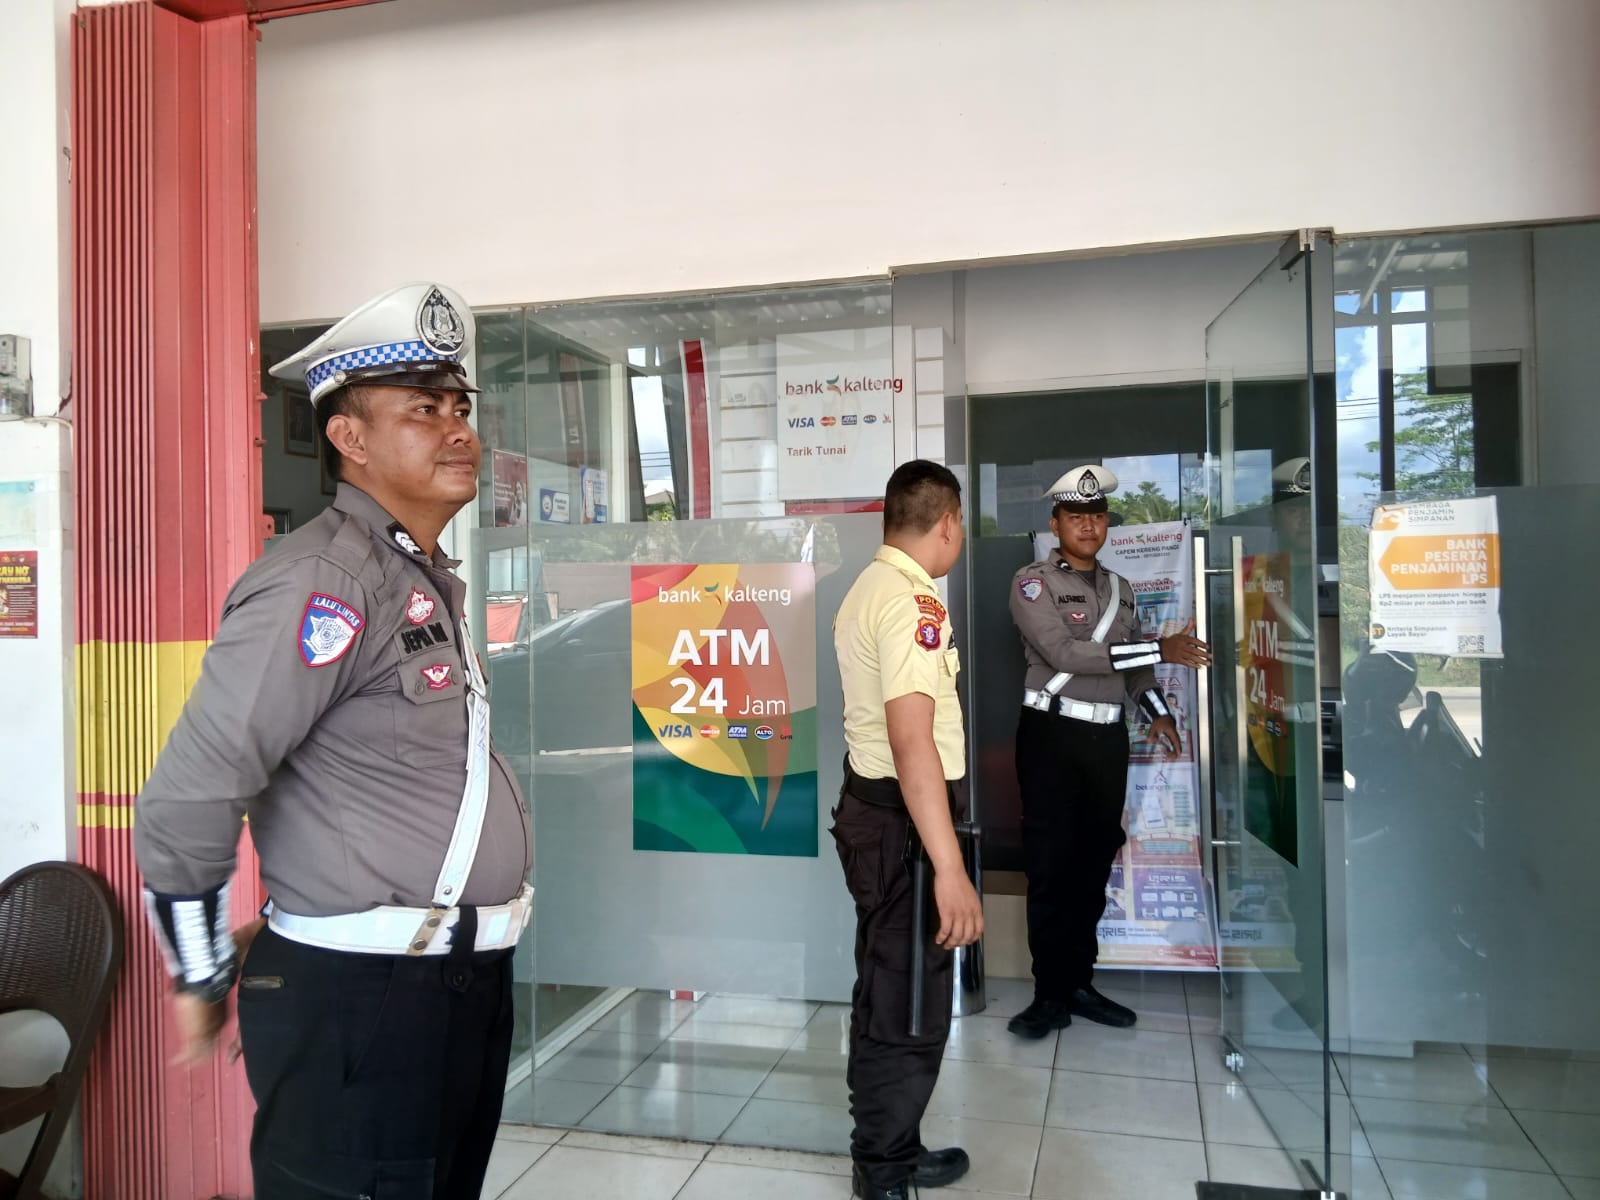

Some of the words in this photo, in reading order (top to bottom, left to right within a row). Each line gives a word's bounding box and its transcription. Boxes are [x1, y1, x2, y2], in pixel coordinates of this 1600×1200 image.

[785, 380, 824, 395] bank
[844, 377, 903, 393] kalteng
[788, 417, 815, 428] VISA
[787, 446, 813, 457] Tarik
[816, 445, 847, 456] Tunai
[1111, 537, 1134, 545] bank
[1147, 533, 1183, 542] kalteng
[1446, 539, 1486, 550] BANK
[1425, 551, 1487, 562] PESERTA
[1391, 562, 1487, 574] PENJAMINAN
[1462, 574, 1487, 584] LPS
[658, 586, 701, 603] bank
[725, 584, 792, 605] kalteng
[314, 596, 337, 609] LALU
[336, 604, 360, 627] LINTAS
[1249, 620, 1279, 660] ATM
[667, 628, 770, 666] ATM
[670, 677, 727, 714] 24
[739, 695, 786, 715] Jam
[1250, 668, 1267, 706] 24
[1269, 688, 1285, 713] Jam
[659, 725, 692, 738] VISA
[1148, 874, 1186, 884] QRIS
